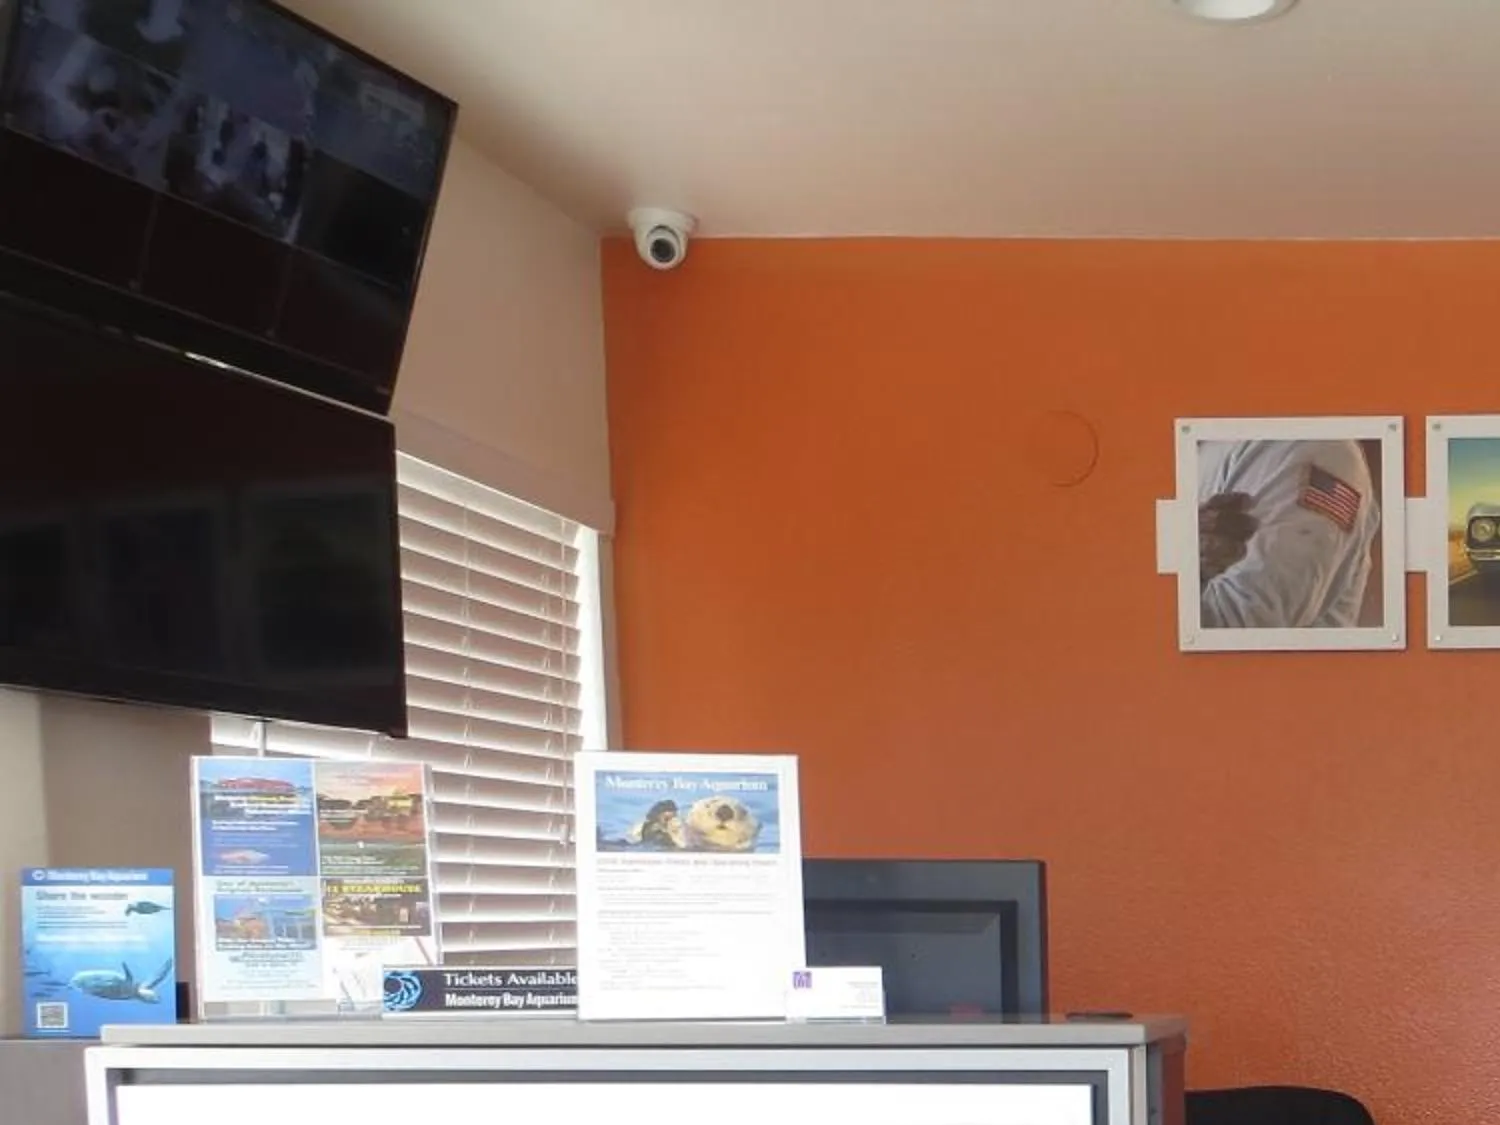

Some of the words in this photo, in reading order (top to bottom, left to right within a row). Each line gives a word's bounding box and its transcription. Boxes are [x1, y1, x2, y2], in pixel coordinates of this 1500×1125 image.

[604, 775, 668, 791] Monterey
[673, 776, 699, 792] Bay
[702, 777, 769, 793] Aquarium
[443, 972, 503, 986] Tickets
[445, 992, 501, 1008] Monterey
[503, 992, 525, 1008] Bay
